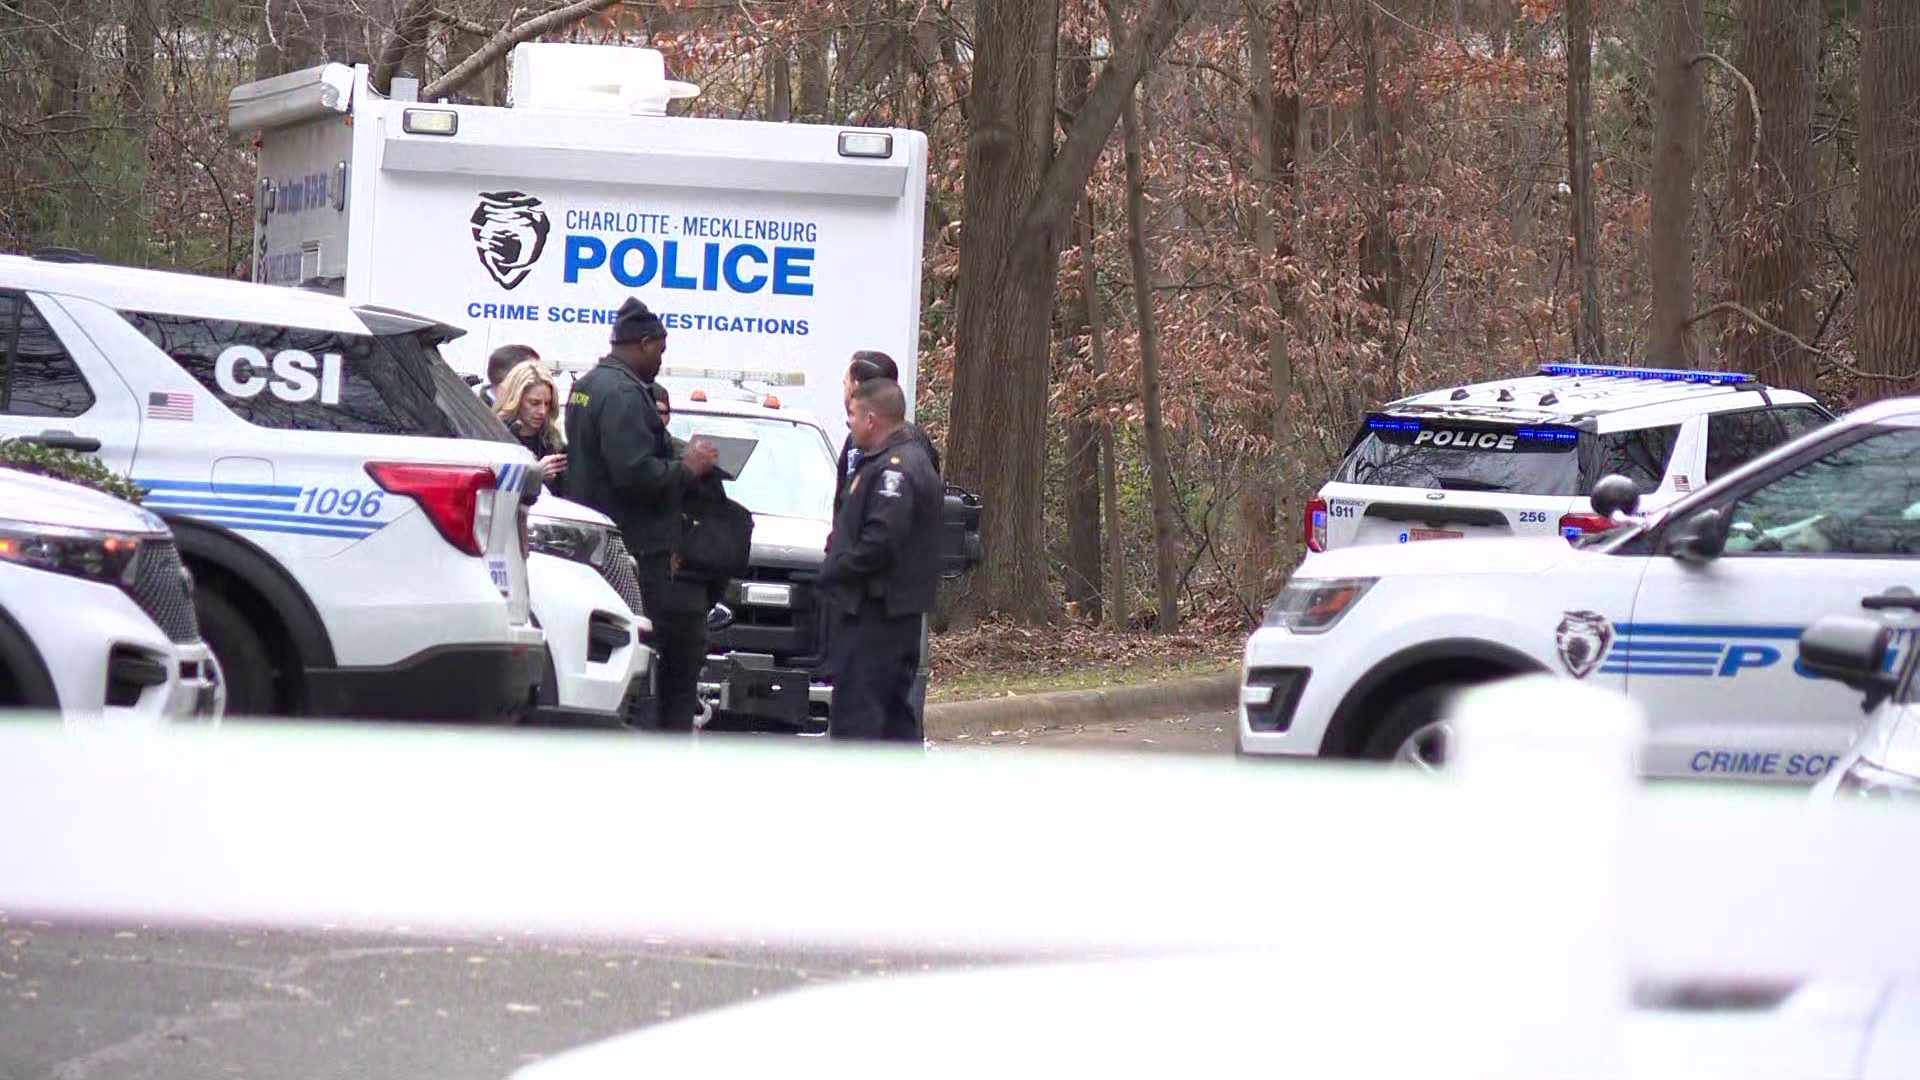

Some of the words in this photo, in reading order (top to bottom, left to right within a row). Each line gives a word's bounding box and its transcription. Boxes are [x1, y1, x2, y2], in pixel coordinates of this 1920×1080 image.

[566, 210, 670, 234] CHARLOTTE
[683, 216, 817, 242] MECKLENBURG
[564, 235, 815, 296] POLICE
[467, 303, 539, 321] CRIME
[548, 306, 617, 325] SCENE
[655, 313, 809, 336] ESTIGATIONS
[215, 345, 341, 404] CSI
[1414, 430, 1518, 450] POLICE
[303, 487, 384, 518] 1096
[1336, 506, 1354, 517] 911
[1519, 511, 1546, 523] 256
[1692, 751, 1781, 775] CRIME
